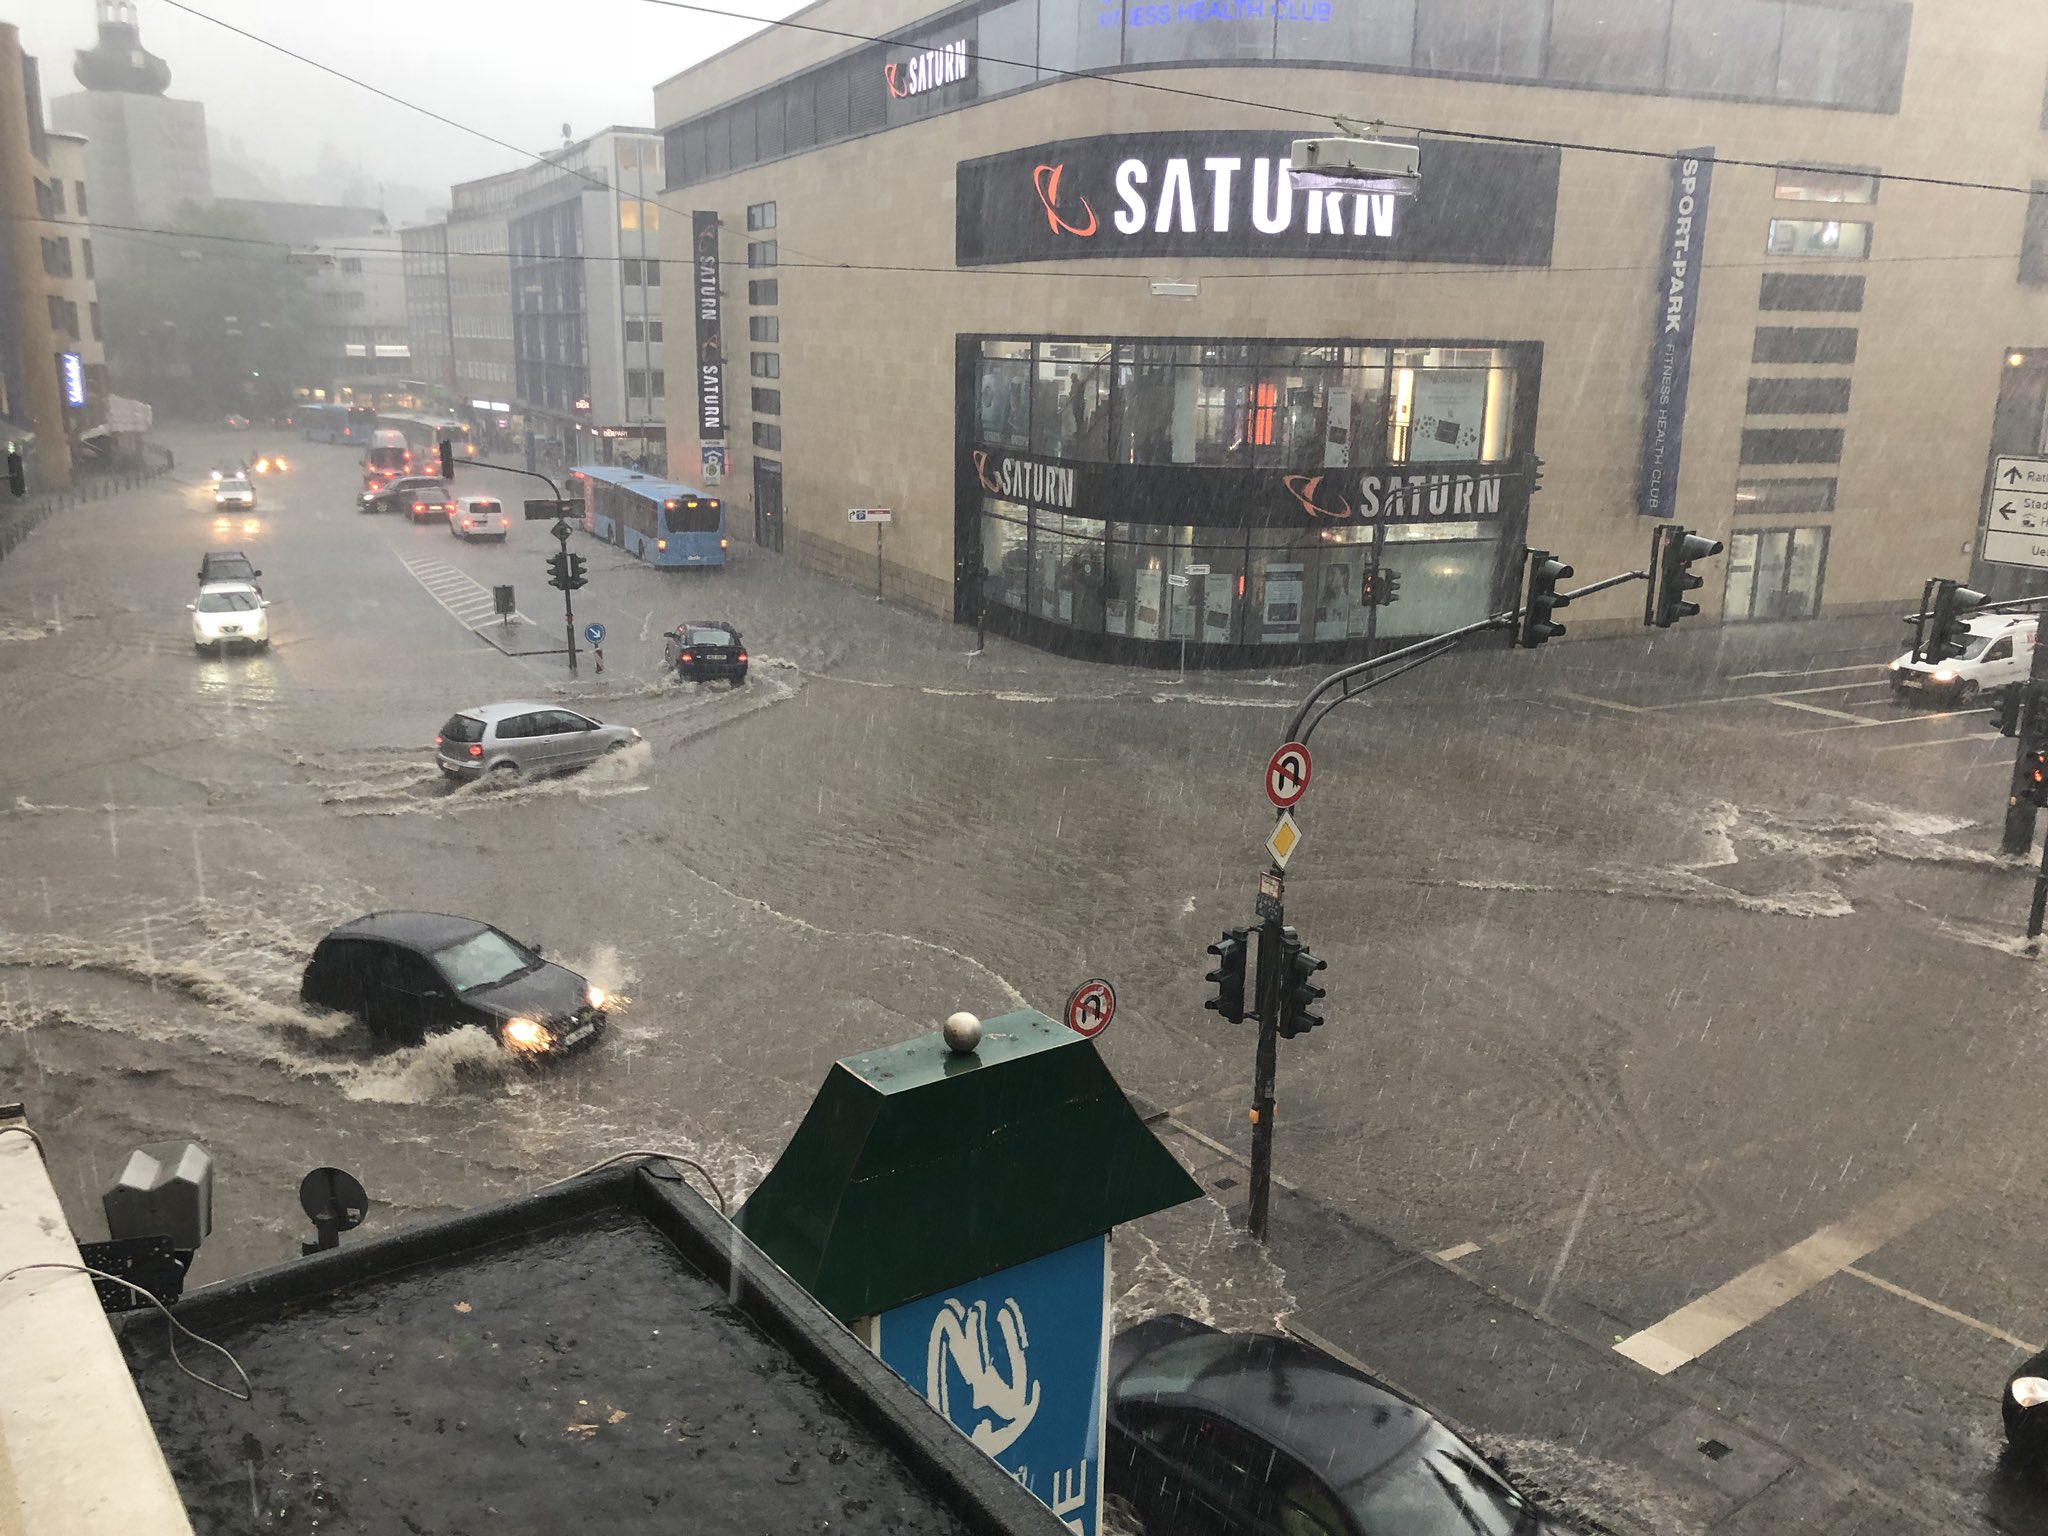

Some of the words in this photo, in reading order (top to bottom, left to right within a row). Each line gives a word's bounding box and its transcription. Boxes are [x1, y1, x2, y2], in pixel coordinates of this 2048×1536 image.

[1178, 0, 1263, 22] HEALTH
[1271, 0, 1331, 22] CLUB
[909, 39, 966, 95] SATURN
[1114, 158, 1395, 237] SATURN
[1665, 158, 1698, 333] SPORT-PARK
[700, 256, 716, 320] SATURN
[703, 365, 719, 428] SATURN
[1660, 344, 1675, 405] FITNESS
[1655, 409, 1668, 465] HEALTH
[1002, 458, 1074, 508] SATURN
[1361, 474, 1501, 518] SATURN
[1650, 469, 1662, 508] CLUB
